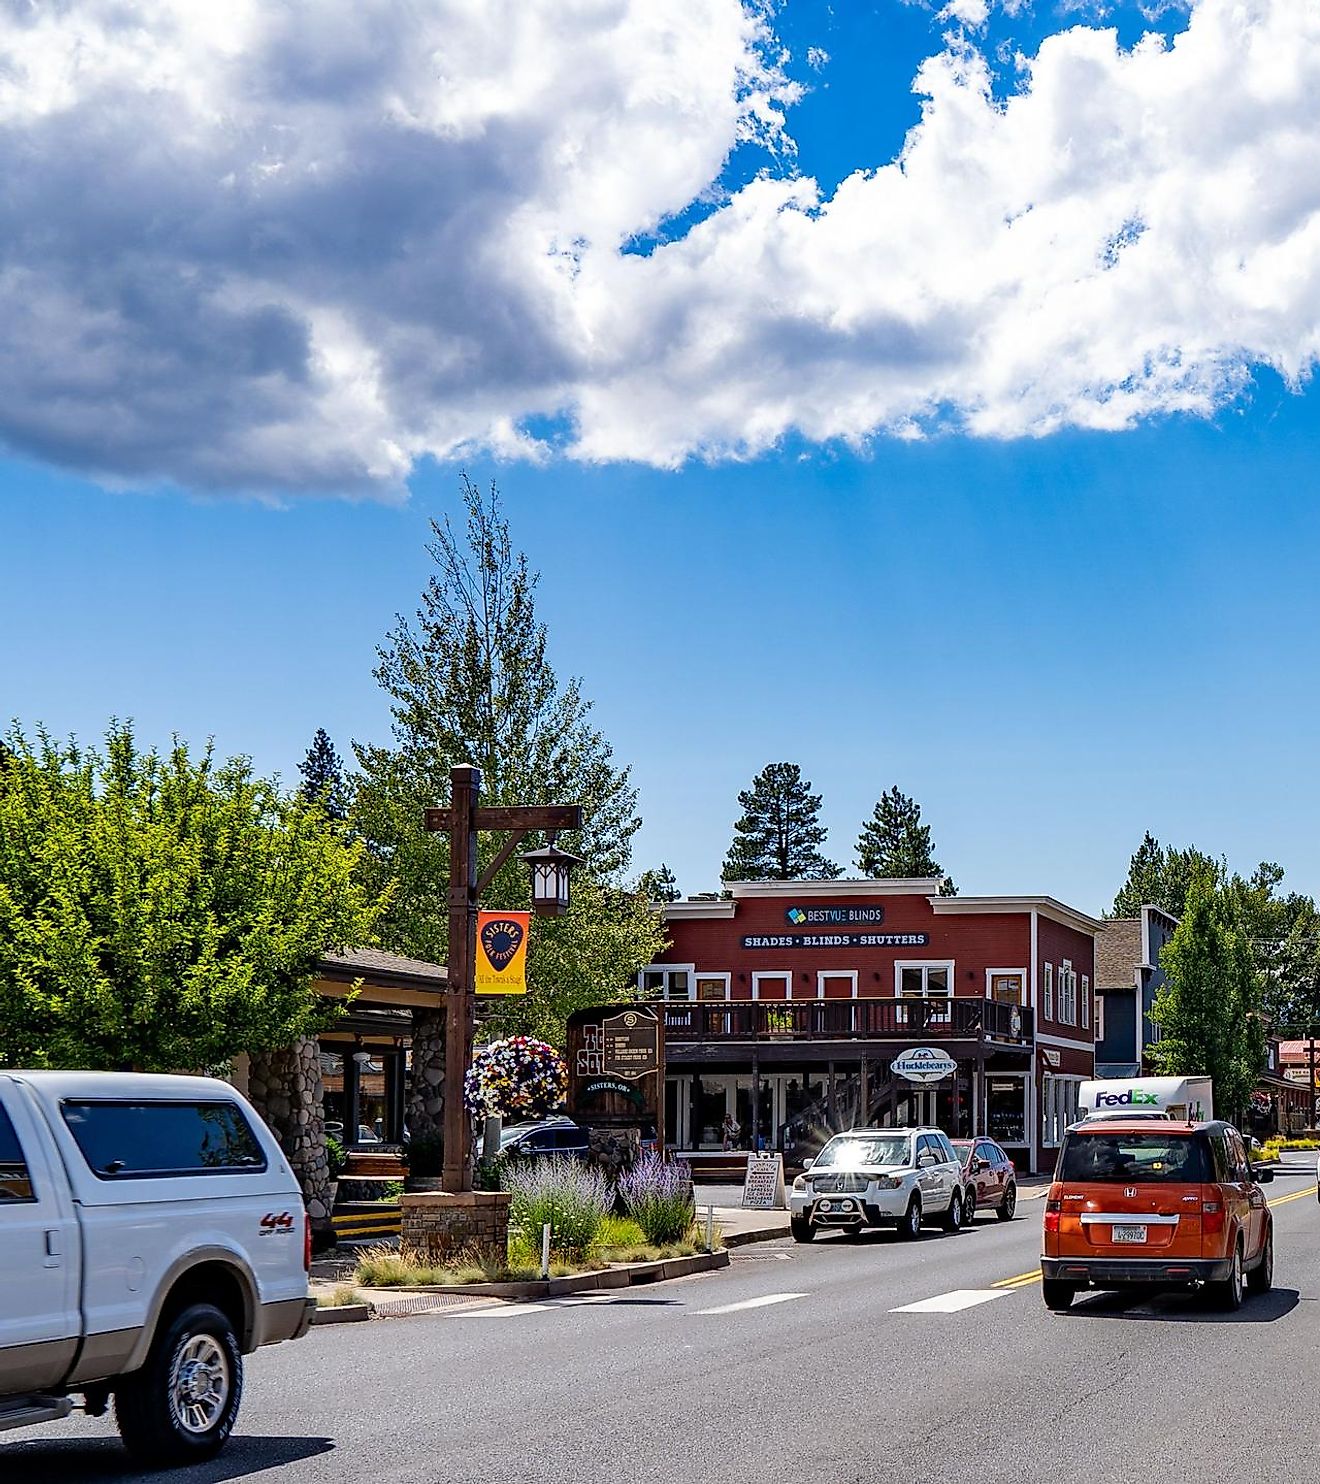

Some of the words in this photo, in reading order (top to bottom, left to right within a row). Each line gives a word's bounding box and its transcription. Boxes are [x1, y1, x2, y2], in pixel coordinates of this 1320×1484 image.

[848, 909, 881, 921] BLINDS
[485, 922, 519, 938] SISTERS
[744, 936, 793, 947] SHADES
[803, 935, 850, 946] BLINDS
[860, 934, 925, 945] SHUTTERS
[1095, 1088, 1159, 1108] FedEx
